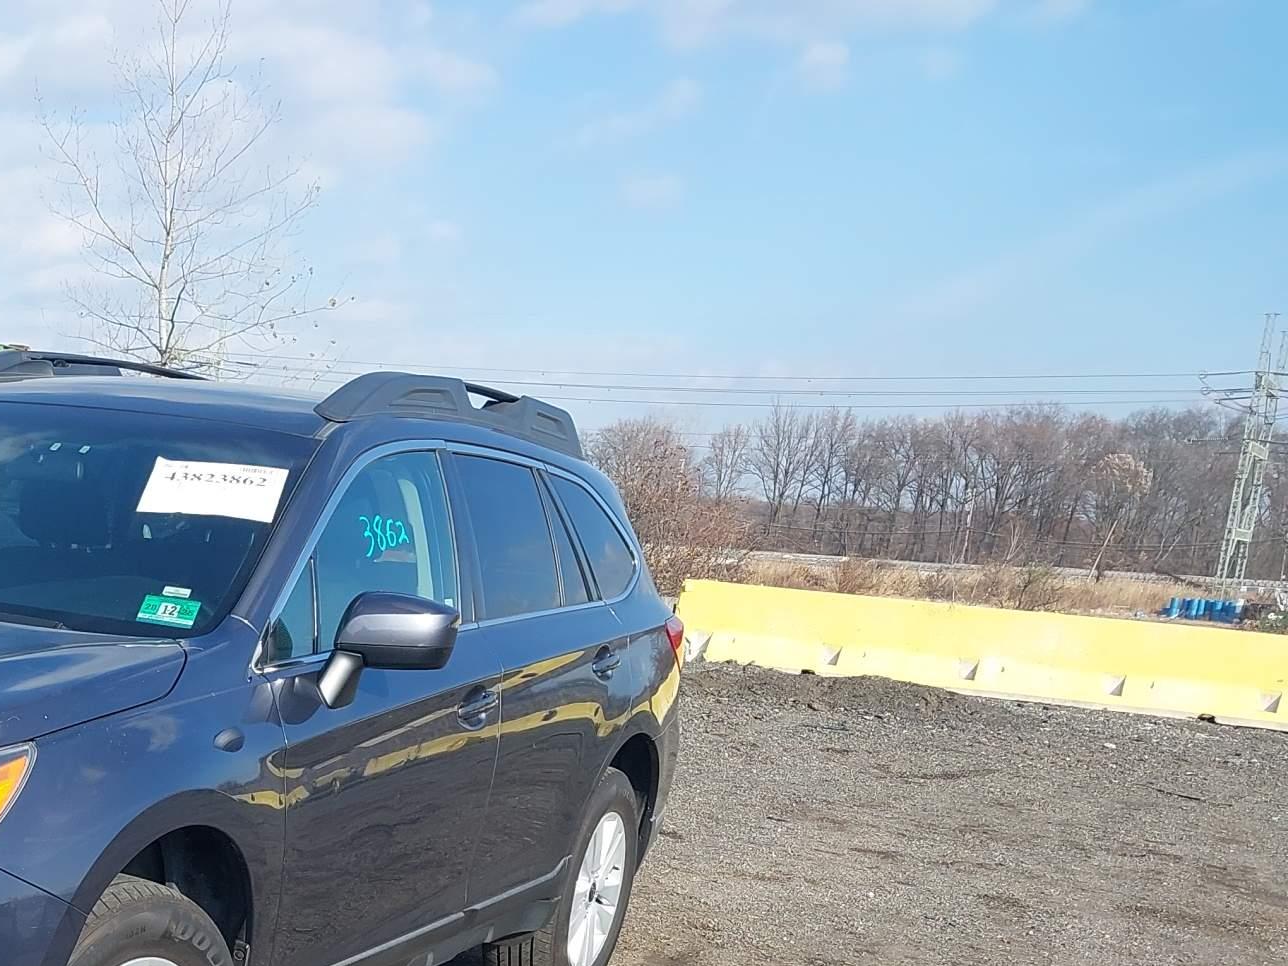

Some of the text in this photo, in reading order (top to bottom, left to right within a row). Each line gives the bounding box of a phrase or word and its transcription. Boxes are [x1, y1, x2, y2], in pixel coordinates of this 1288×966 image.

[164, 469, 268, 488] 43823862
[359, 515, 410, 557] 3862
[161, 605, 178, 616] 12
